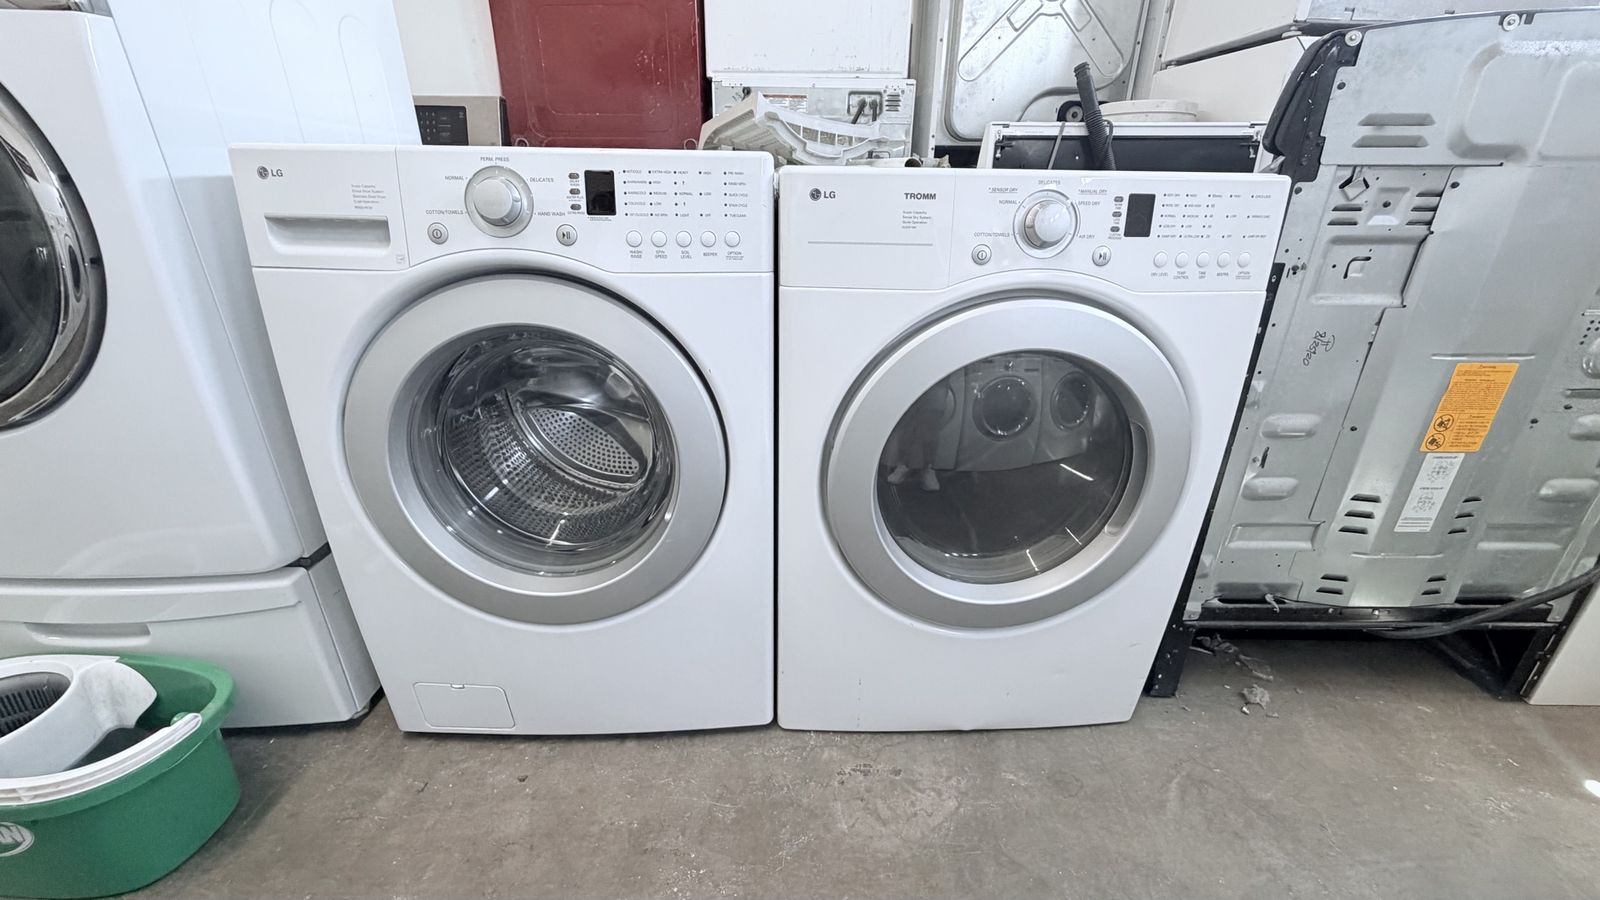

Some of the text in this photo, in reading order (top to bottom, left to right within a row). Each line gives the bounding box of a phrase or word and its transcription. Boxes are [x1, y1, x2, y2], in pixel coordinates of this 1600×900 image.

[271, 169, 283, 178] LG
[823, 191, 836, 199] LG
[904, 192, 936, 200] TROMM
[1302, 330, 1331, 366] 8/25/20
